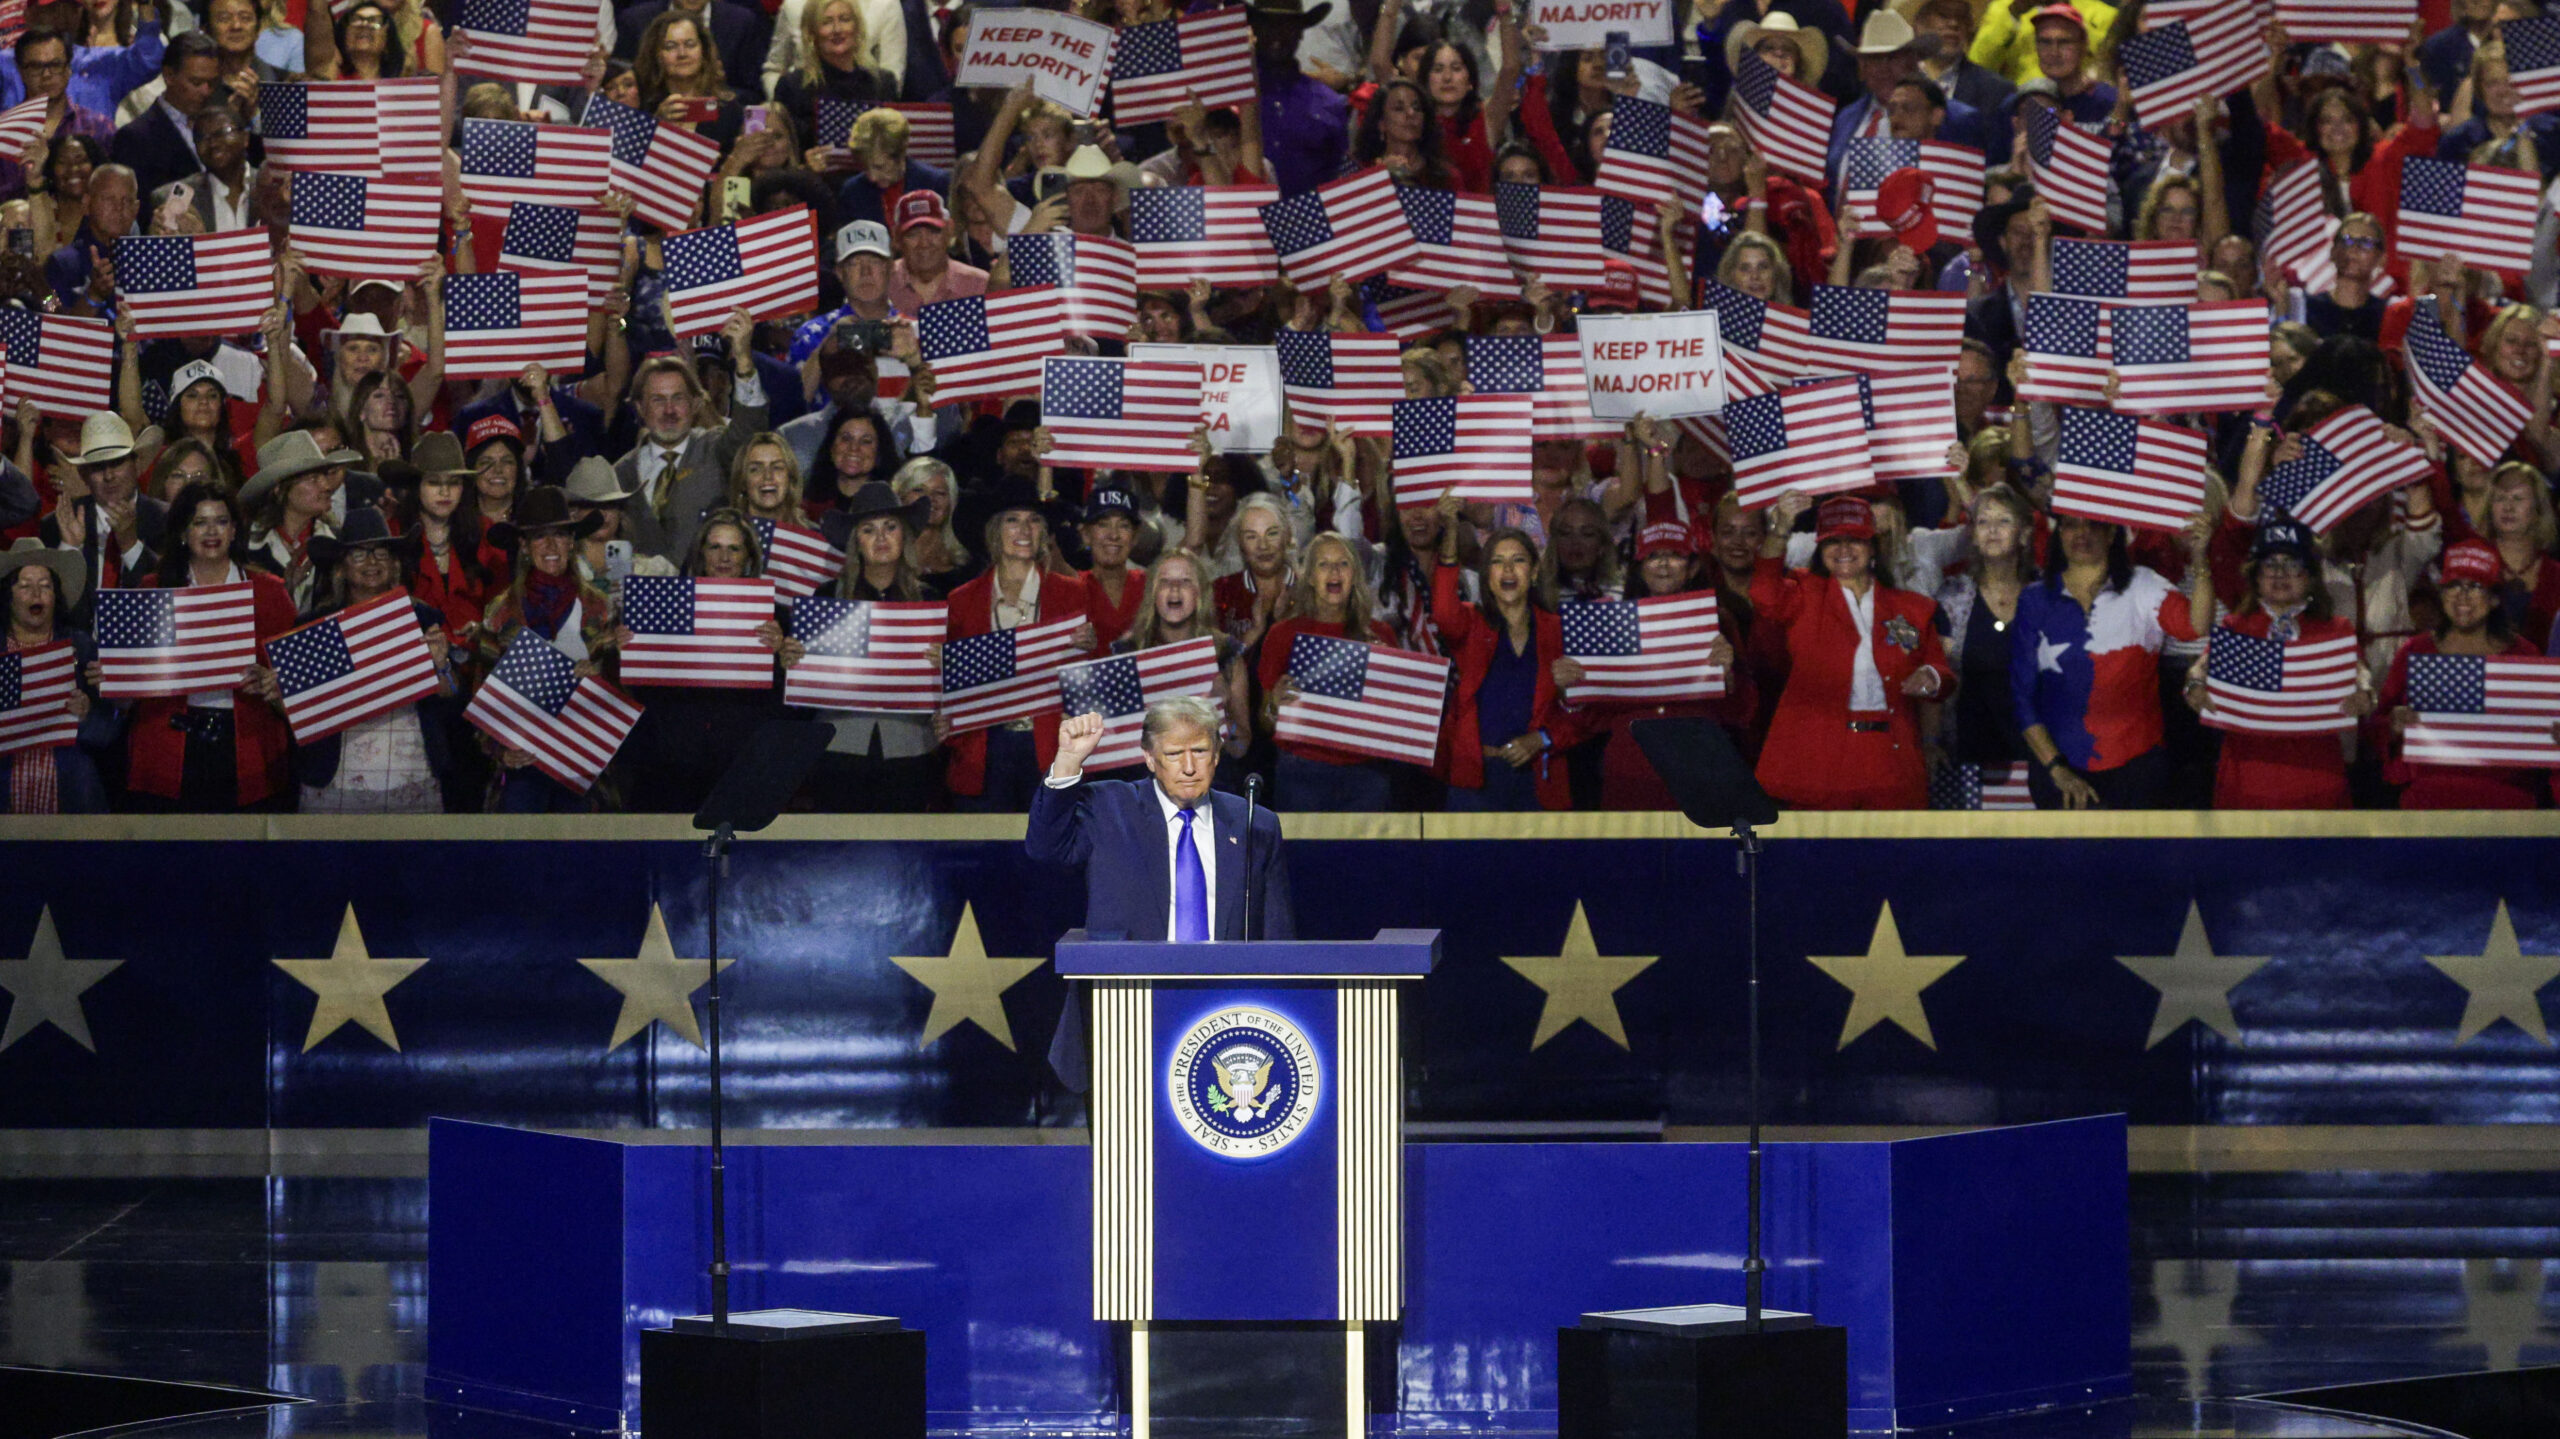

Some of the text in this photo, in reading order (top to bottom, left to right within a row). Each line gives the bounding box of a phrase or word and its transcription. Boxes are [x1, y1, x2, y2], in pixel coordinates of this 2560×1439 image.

[1539, 2, 1661, 23] MAJORITY
[979, 27, 1096, 59] KEEP THE
[968, 51, 1093, 87] MAJORITY
[846, 229, 878, 244] USA
[1593, 338, 1705, 361] KEEP THE
[186, 364, 215, 379] USA
[1593, 369, 1715, 393] MAJORITY
[1201, 391, 1230, 404] THE
[1200, 412, 1231, 432] SA
[1099, 491, 1132, 510] USA
[2265, 527, 2299, 544] USA
[1174, 1013, 1314, 1151] SEAL OF THE PRESIDENT OF THE UNITED STATES
